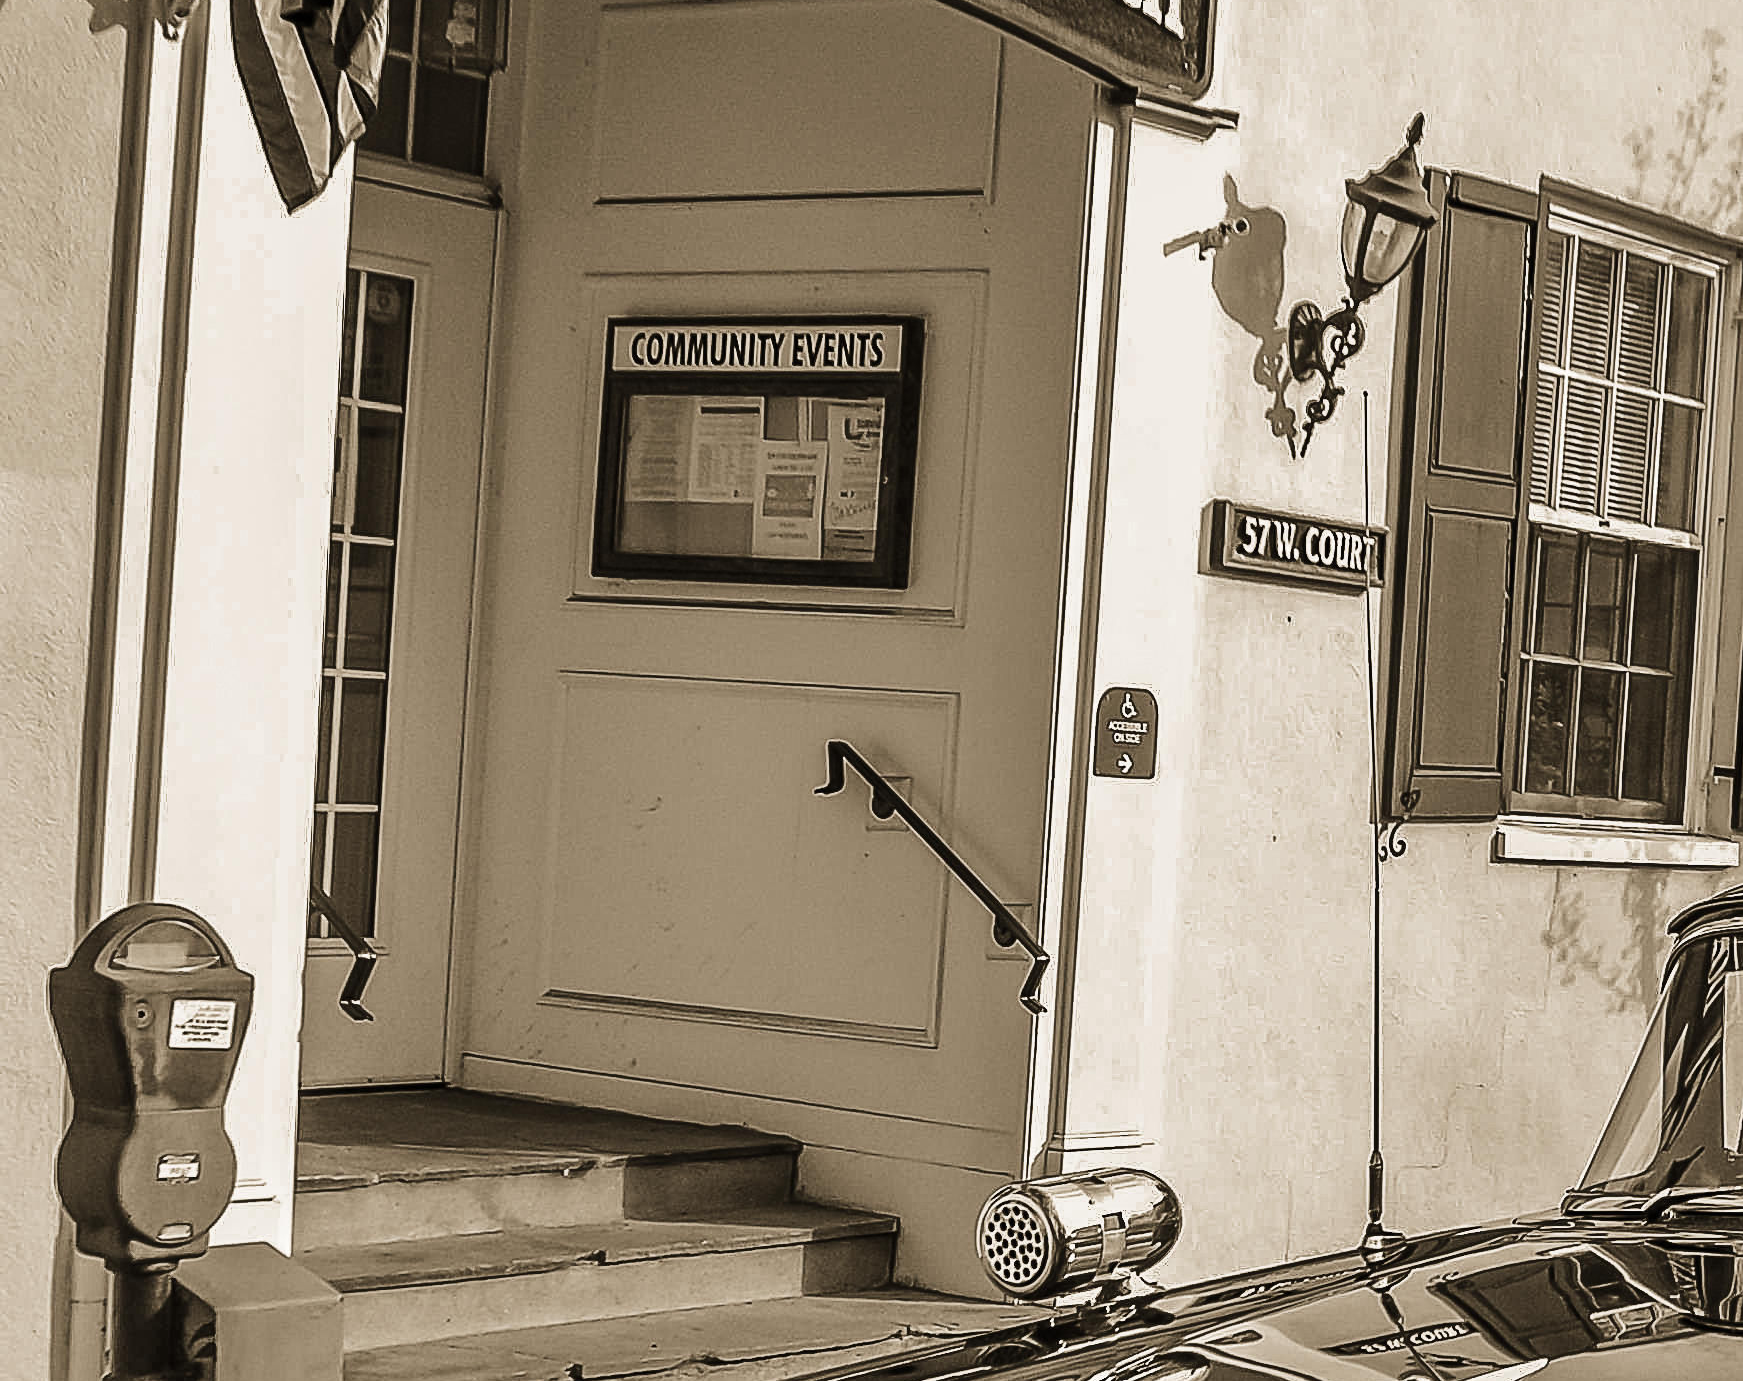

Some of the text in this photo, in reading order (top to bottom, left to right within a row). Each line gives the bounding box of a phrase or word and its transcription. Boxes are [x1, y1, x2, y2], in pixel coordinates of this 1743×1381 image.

[631, 331, 884, 367] COMMUNITY EVENTS
[1241, 516, 1375, 571] 57 W. COURT
